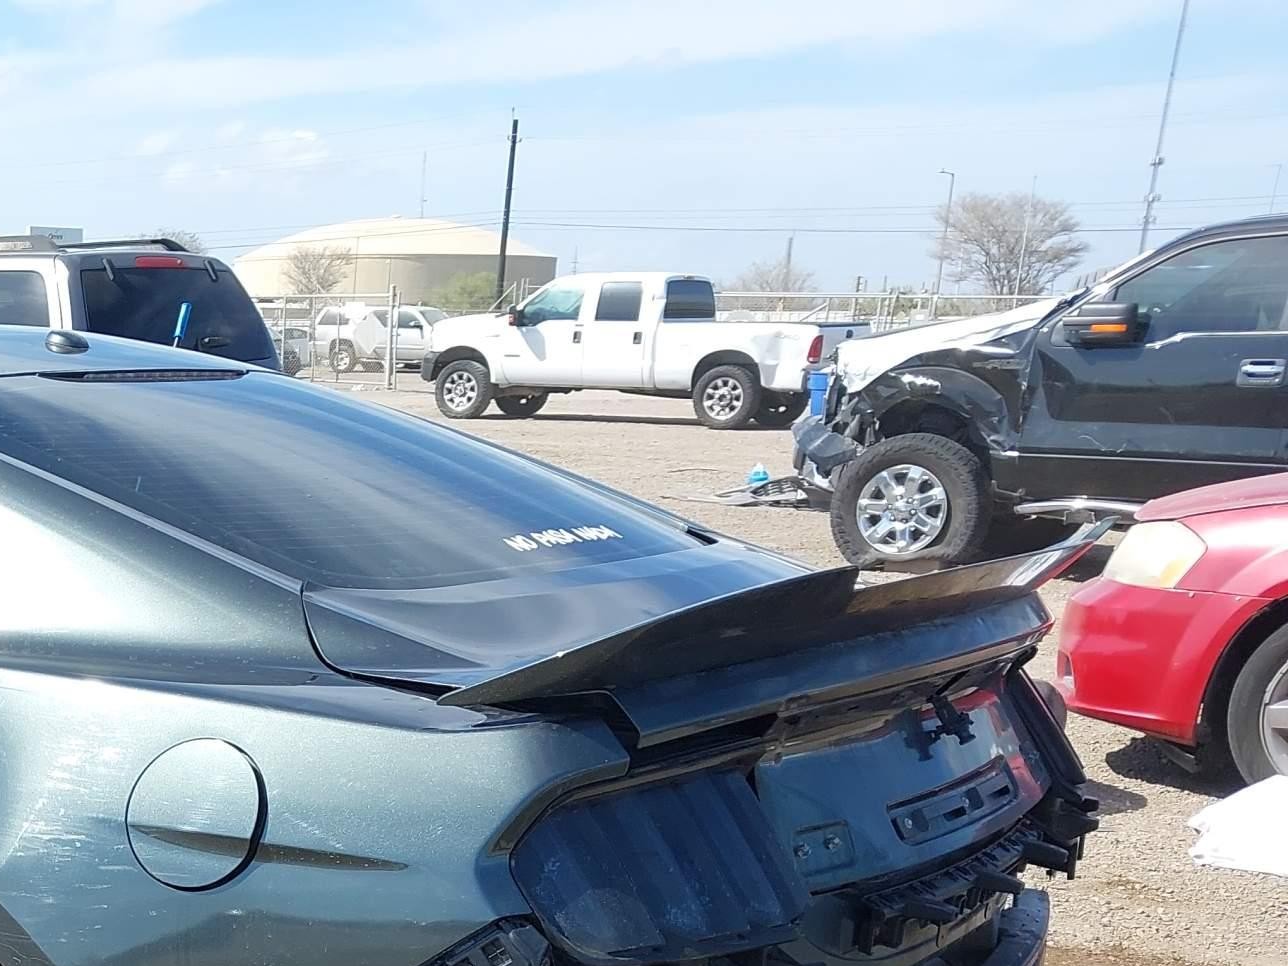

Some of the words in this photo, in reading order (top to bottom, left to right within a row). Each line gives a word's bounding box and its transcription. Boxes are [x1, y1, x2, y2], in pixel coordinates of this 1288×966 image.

[503, 534, 538, 552] NO
[530, 528, 583, 548] PASA
[571, 524, 624, 541] NADA
